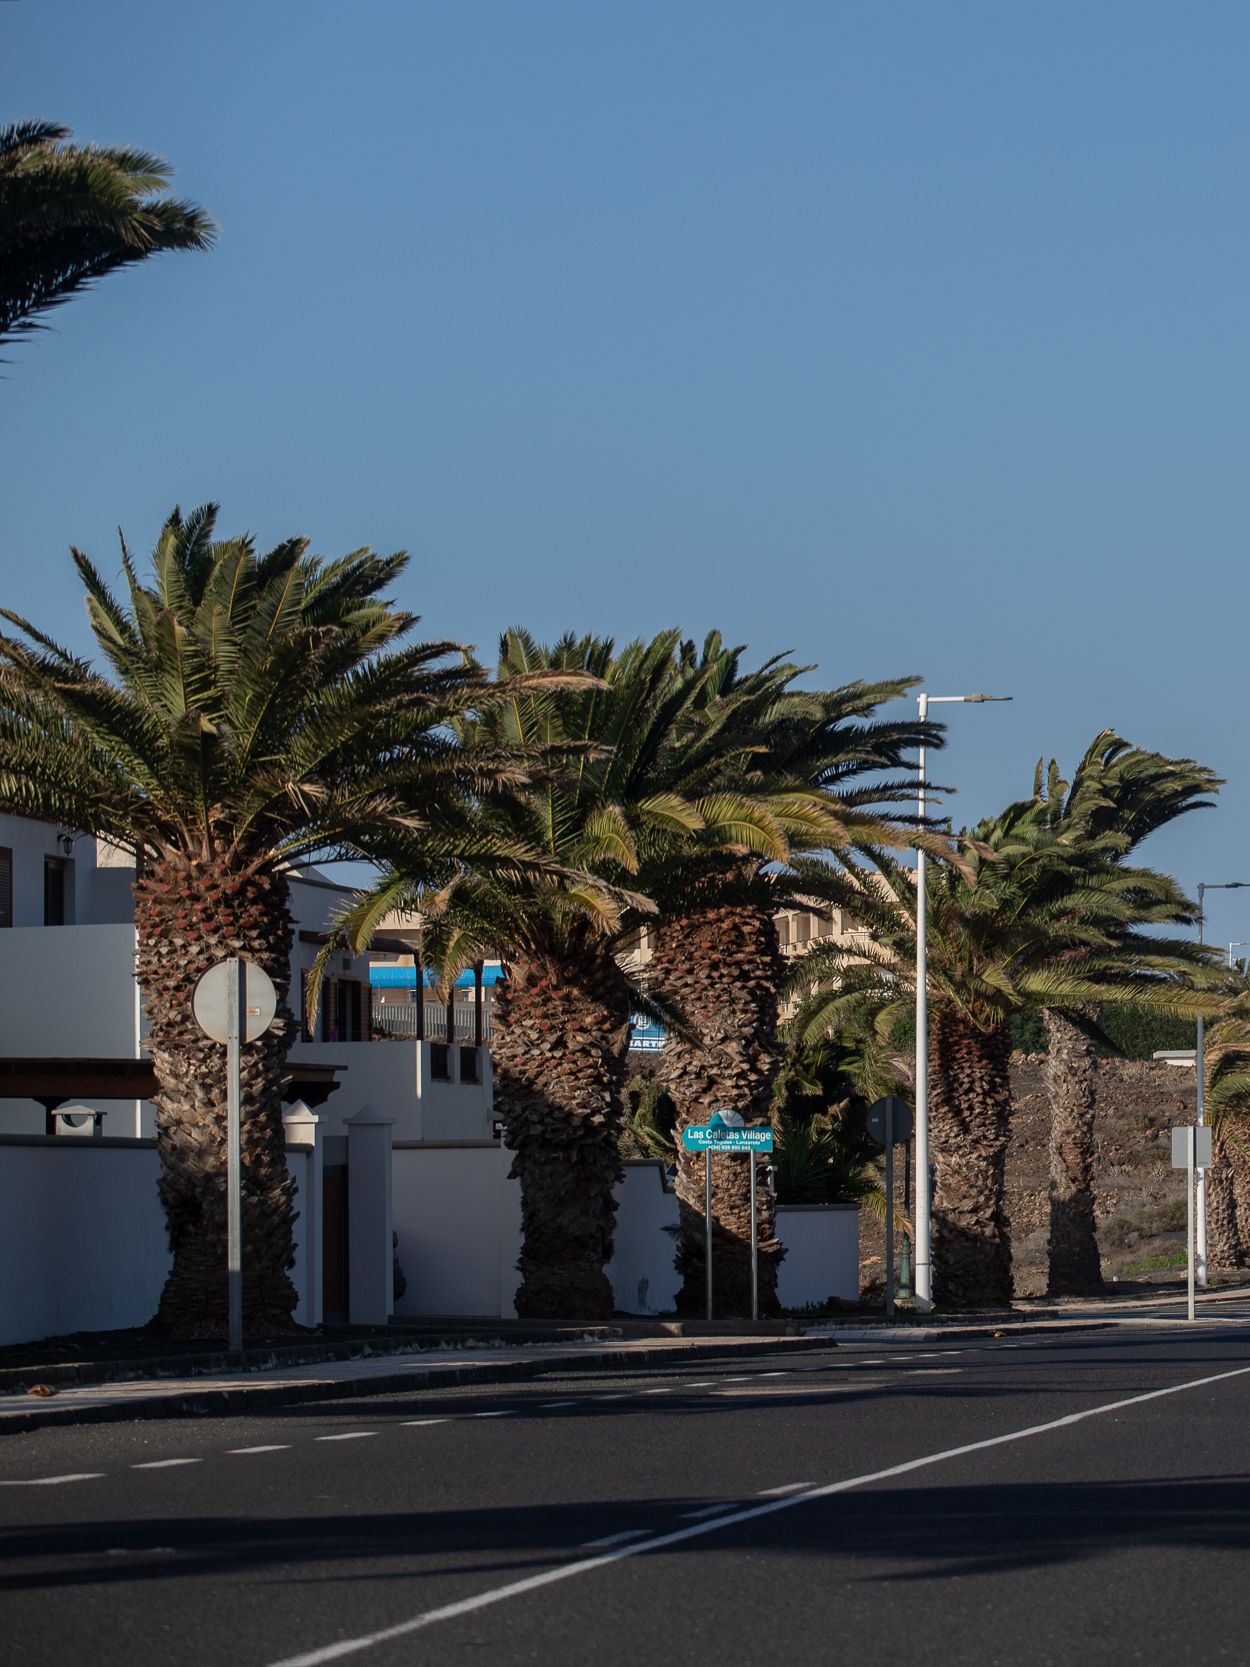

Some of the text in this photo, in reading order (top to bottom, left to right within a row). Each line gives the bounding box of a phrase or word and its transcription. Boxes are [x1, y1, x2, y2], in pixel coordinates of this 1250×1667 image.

[688, 1128, 771, 1142] Las Caletas Village
